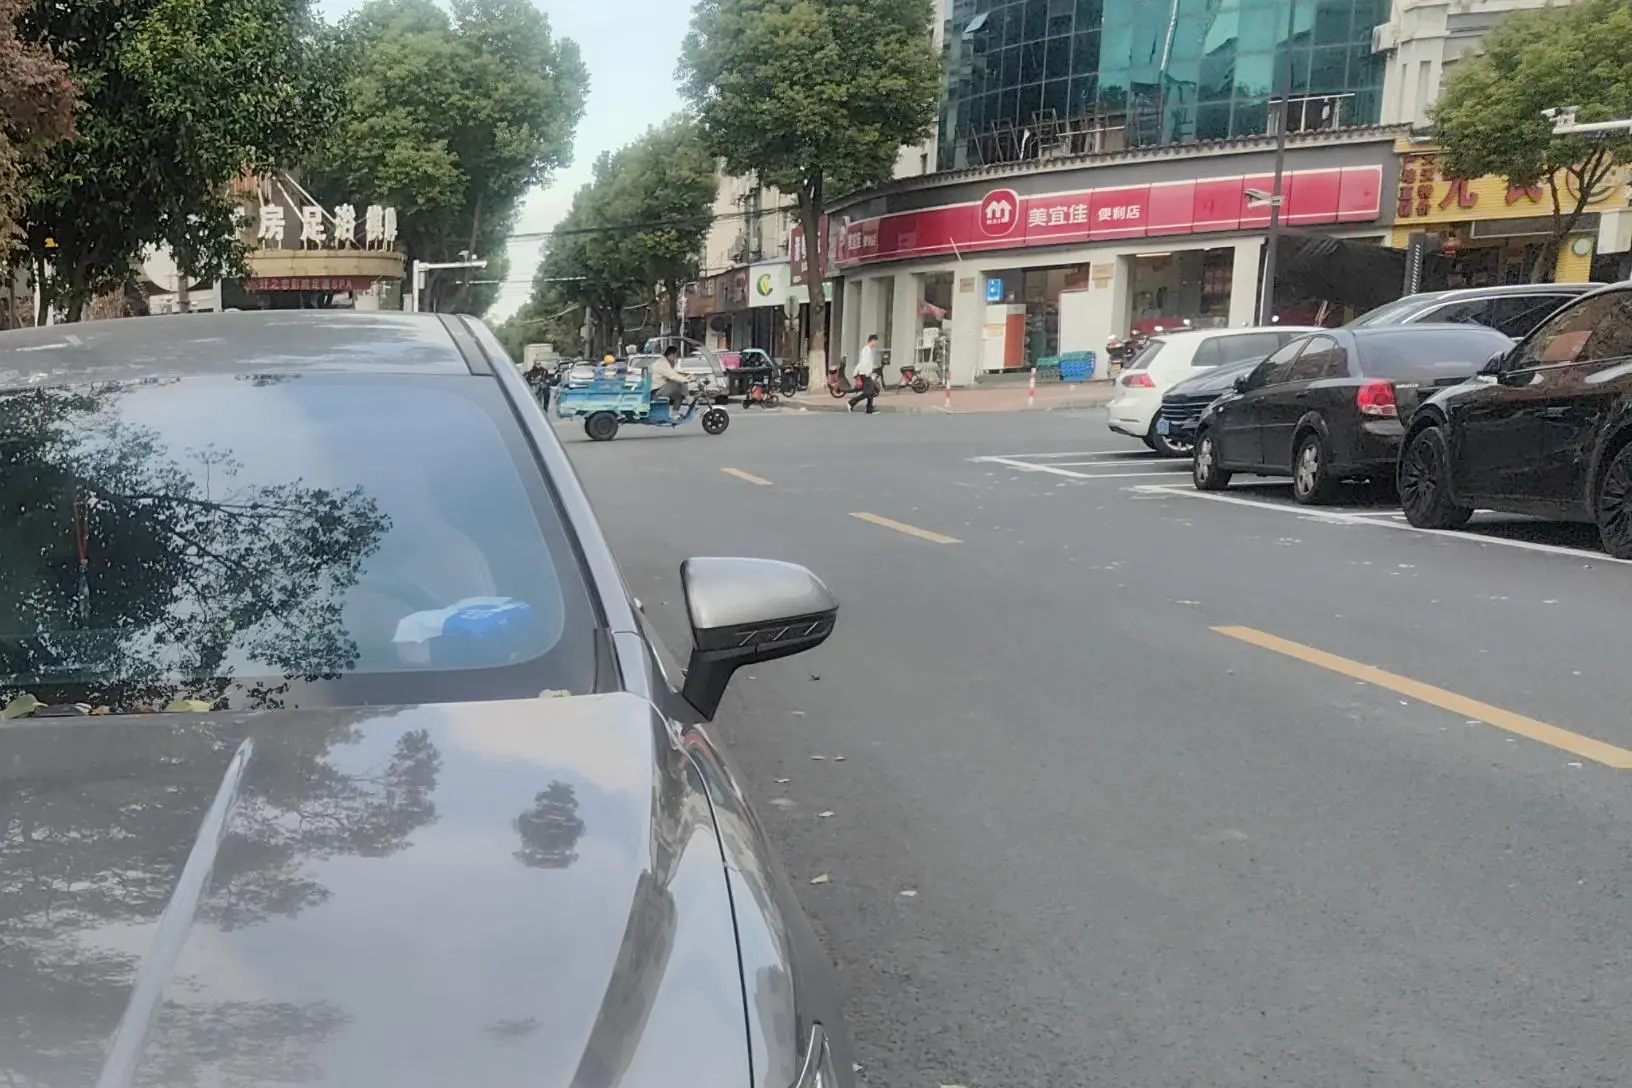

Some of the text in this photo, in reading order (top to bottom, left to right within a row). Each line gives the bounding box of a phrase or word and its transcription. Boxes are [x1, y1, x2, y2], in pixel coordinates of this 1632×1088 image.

[1028, 204, 1141, 227] 美宜佳 便利店
